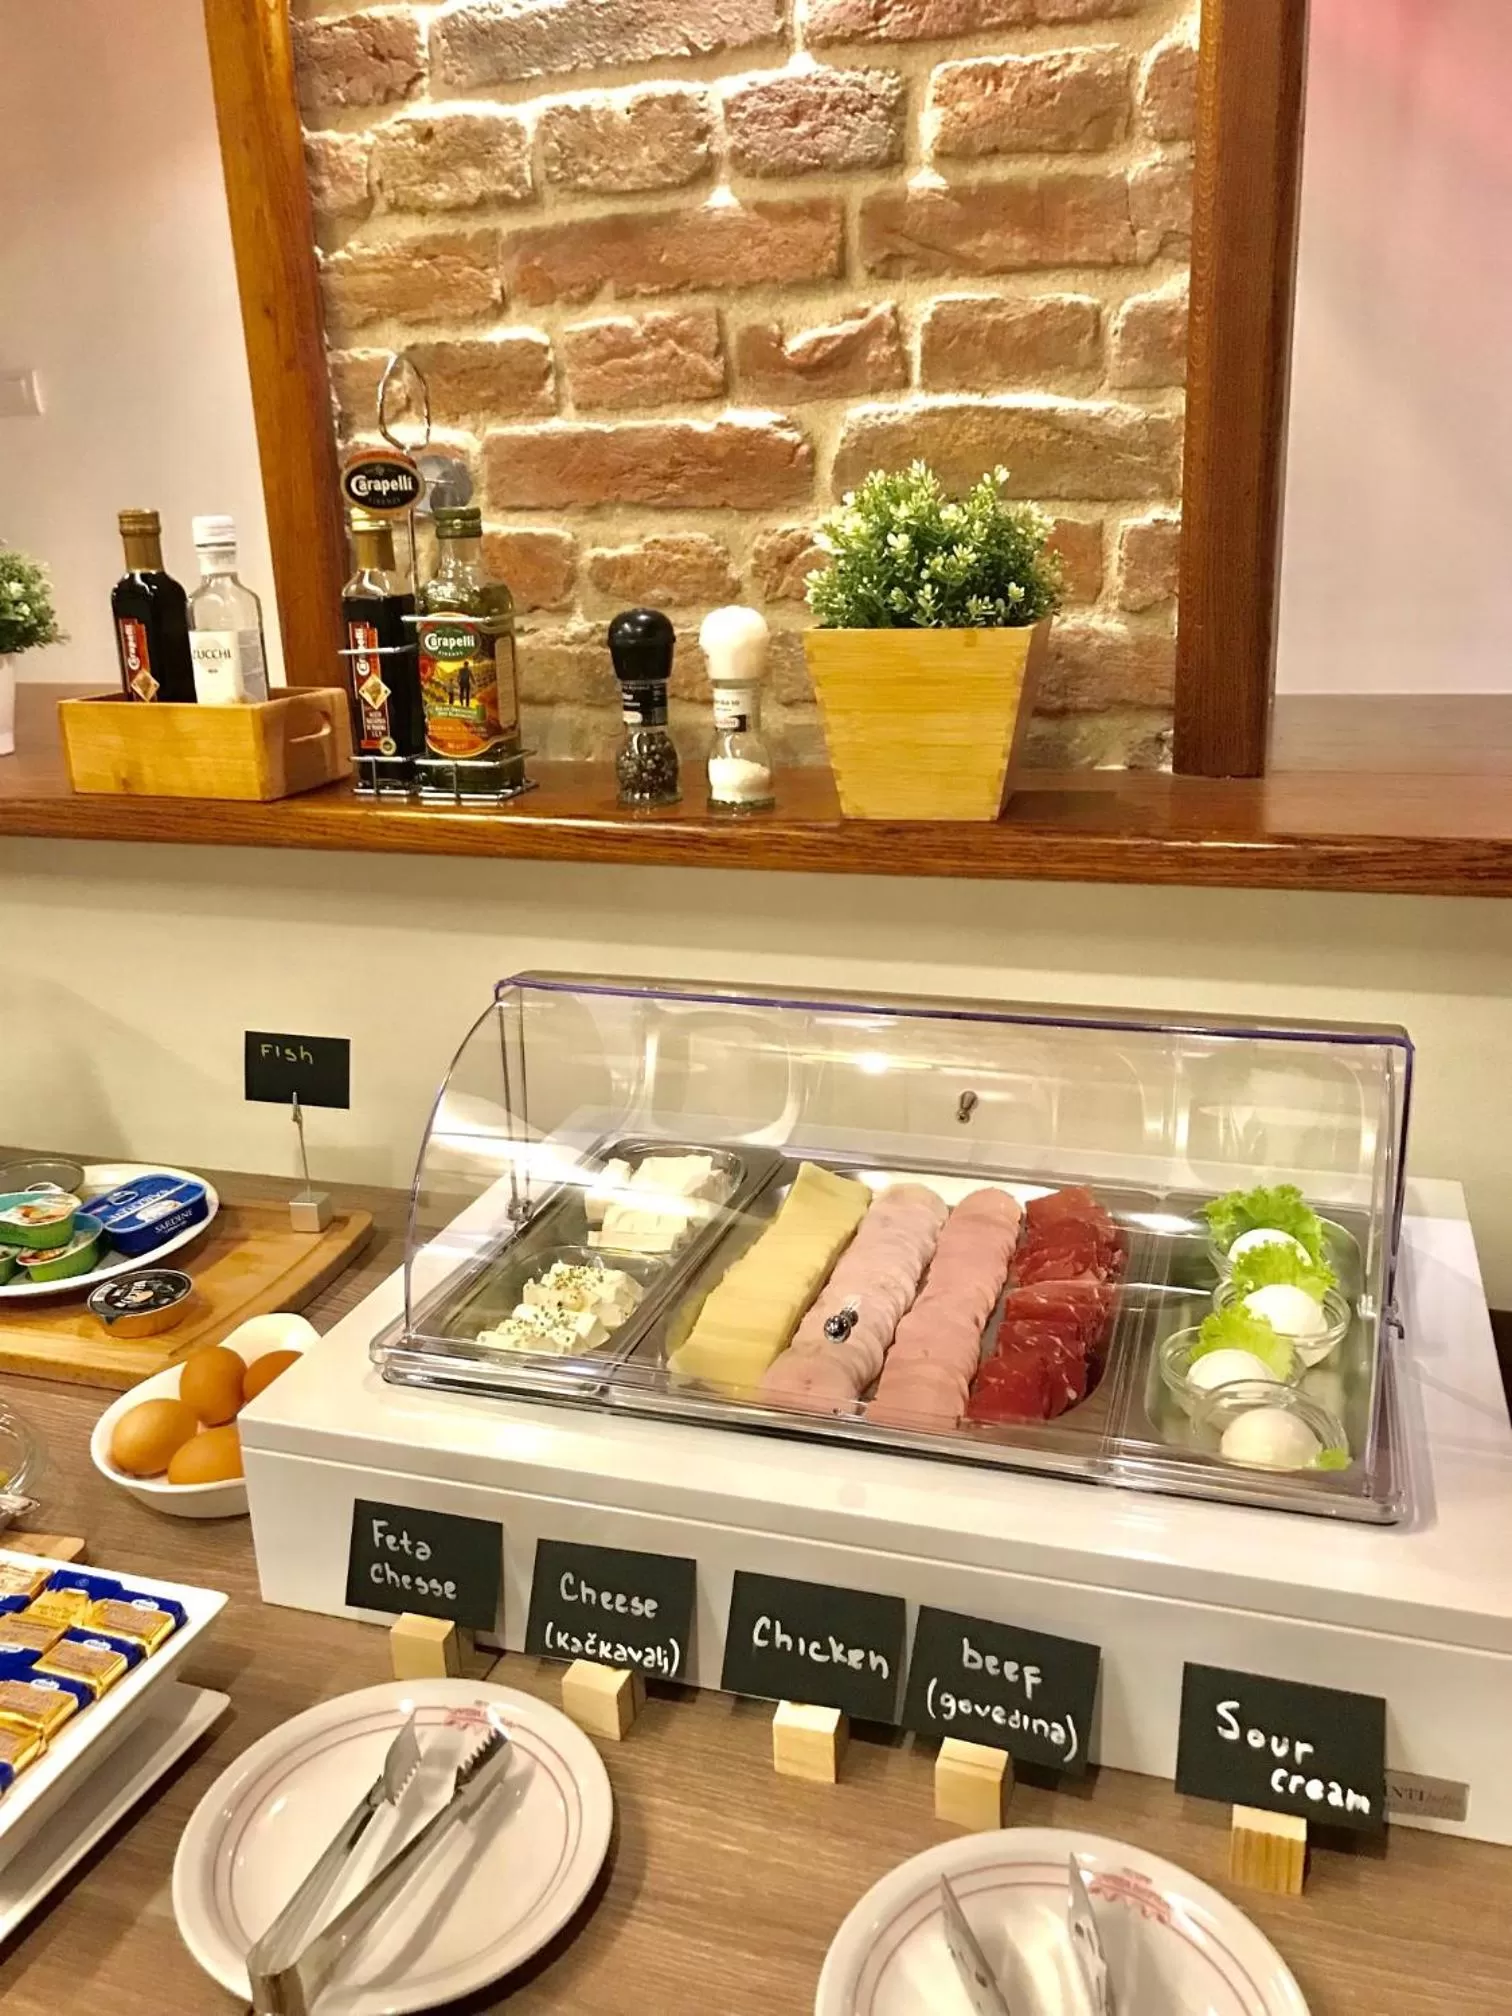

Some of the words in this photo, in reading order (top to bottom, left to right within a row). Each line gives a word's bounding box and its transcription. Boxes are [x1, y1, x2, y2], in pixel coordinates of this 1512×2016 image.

[350, 474, 413, 497] Carapelli
[424, 633, 475, 650] Carapelli
[371, 1519, 432, 1561] Feta
[559, 1571, 659, 1619] Cheese
[752, 1616, 889, 1680] Chicken
[926, 1677, 1077, 1763] (govedina)
[1215, 1700, 1315, 1764] Sour
